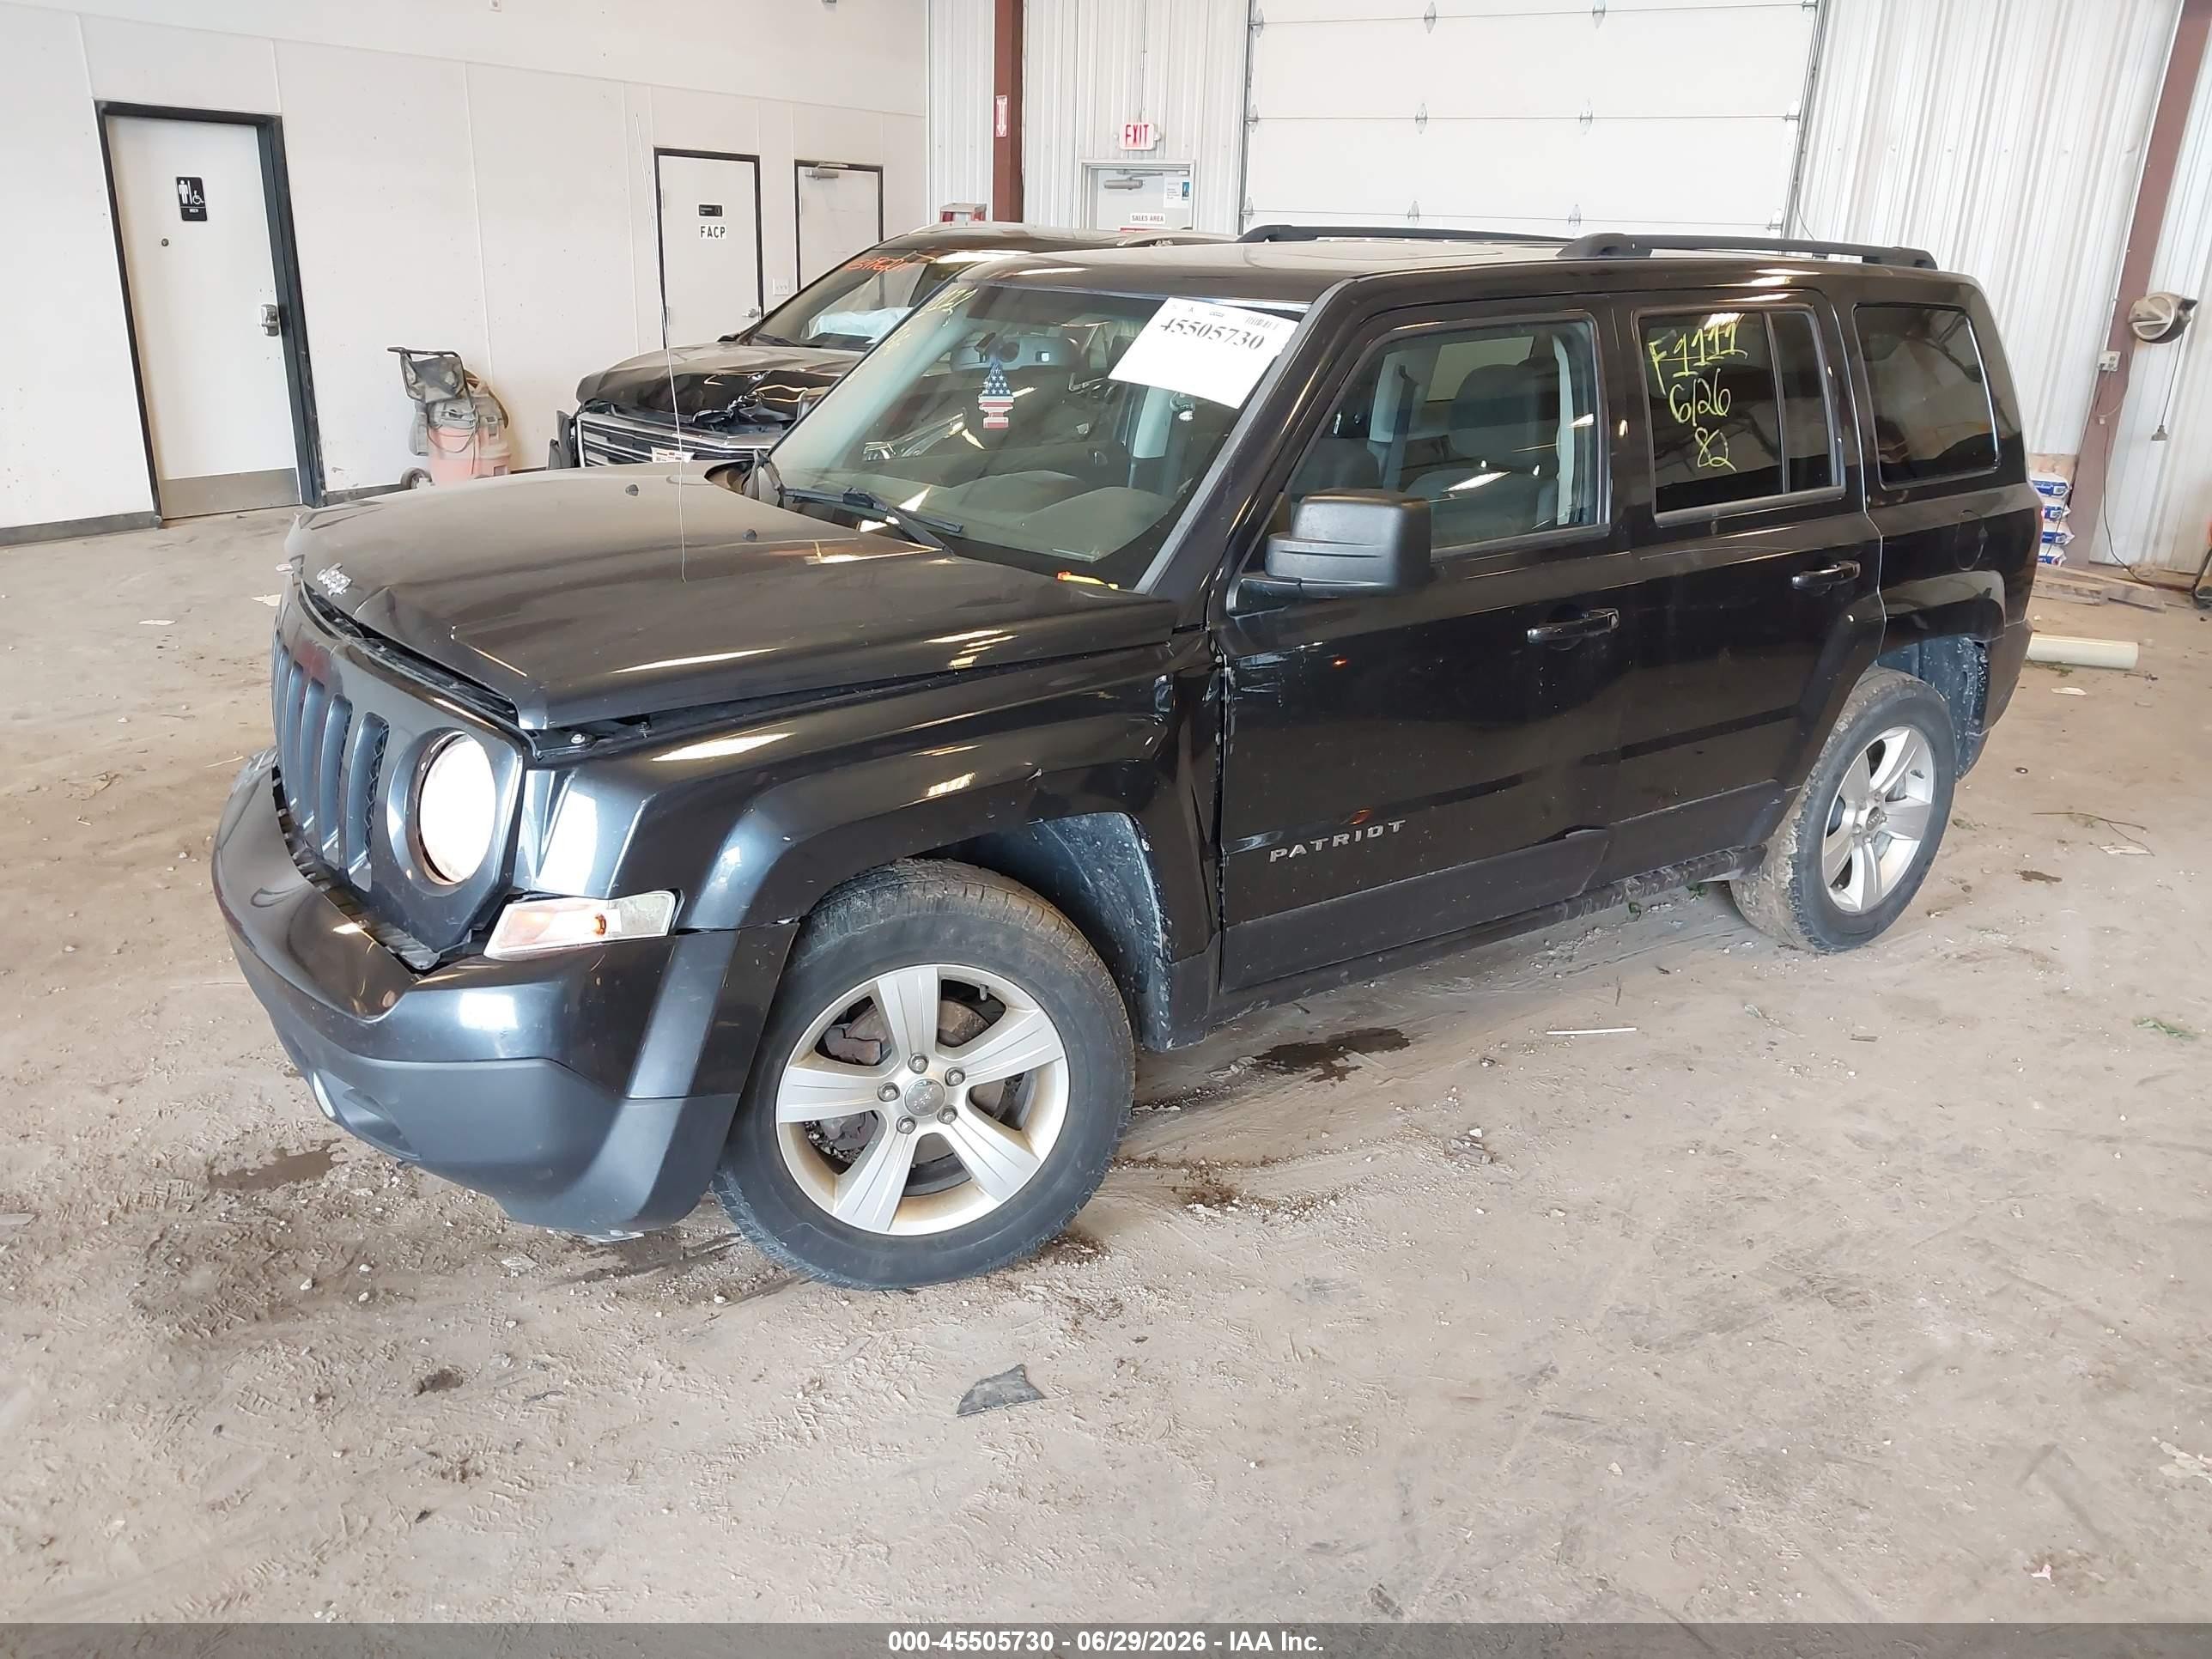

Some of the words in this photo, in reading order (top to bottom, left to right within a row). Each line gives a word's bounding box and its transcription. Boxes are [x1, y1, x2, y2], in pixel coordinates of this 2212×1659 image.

[1125, 124, 1149, 145] EXIT
[700, 225, 726, 238] FACP
[1160, 317, 1265, 349] 45505730
[1269, 819, 1407, 863] PATRIOT
